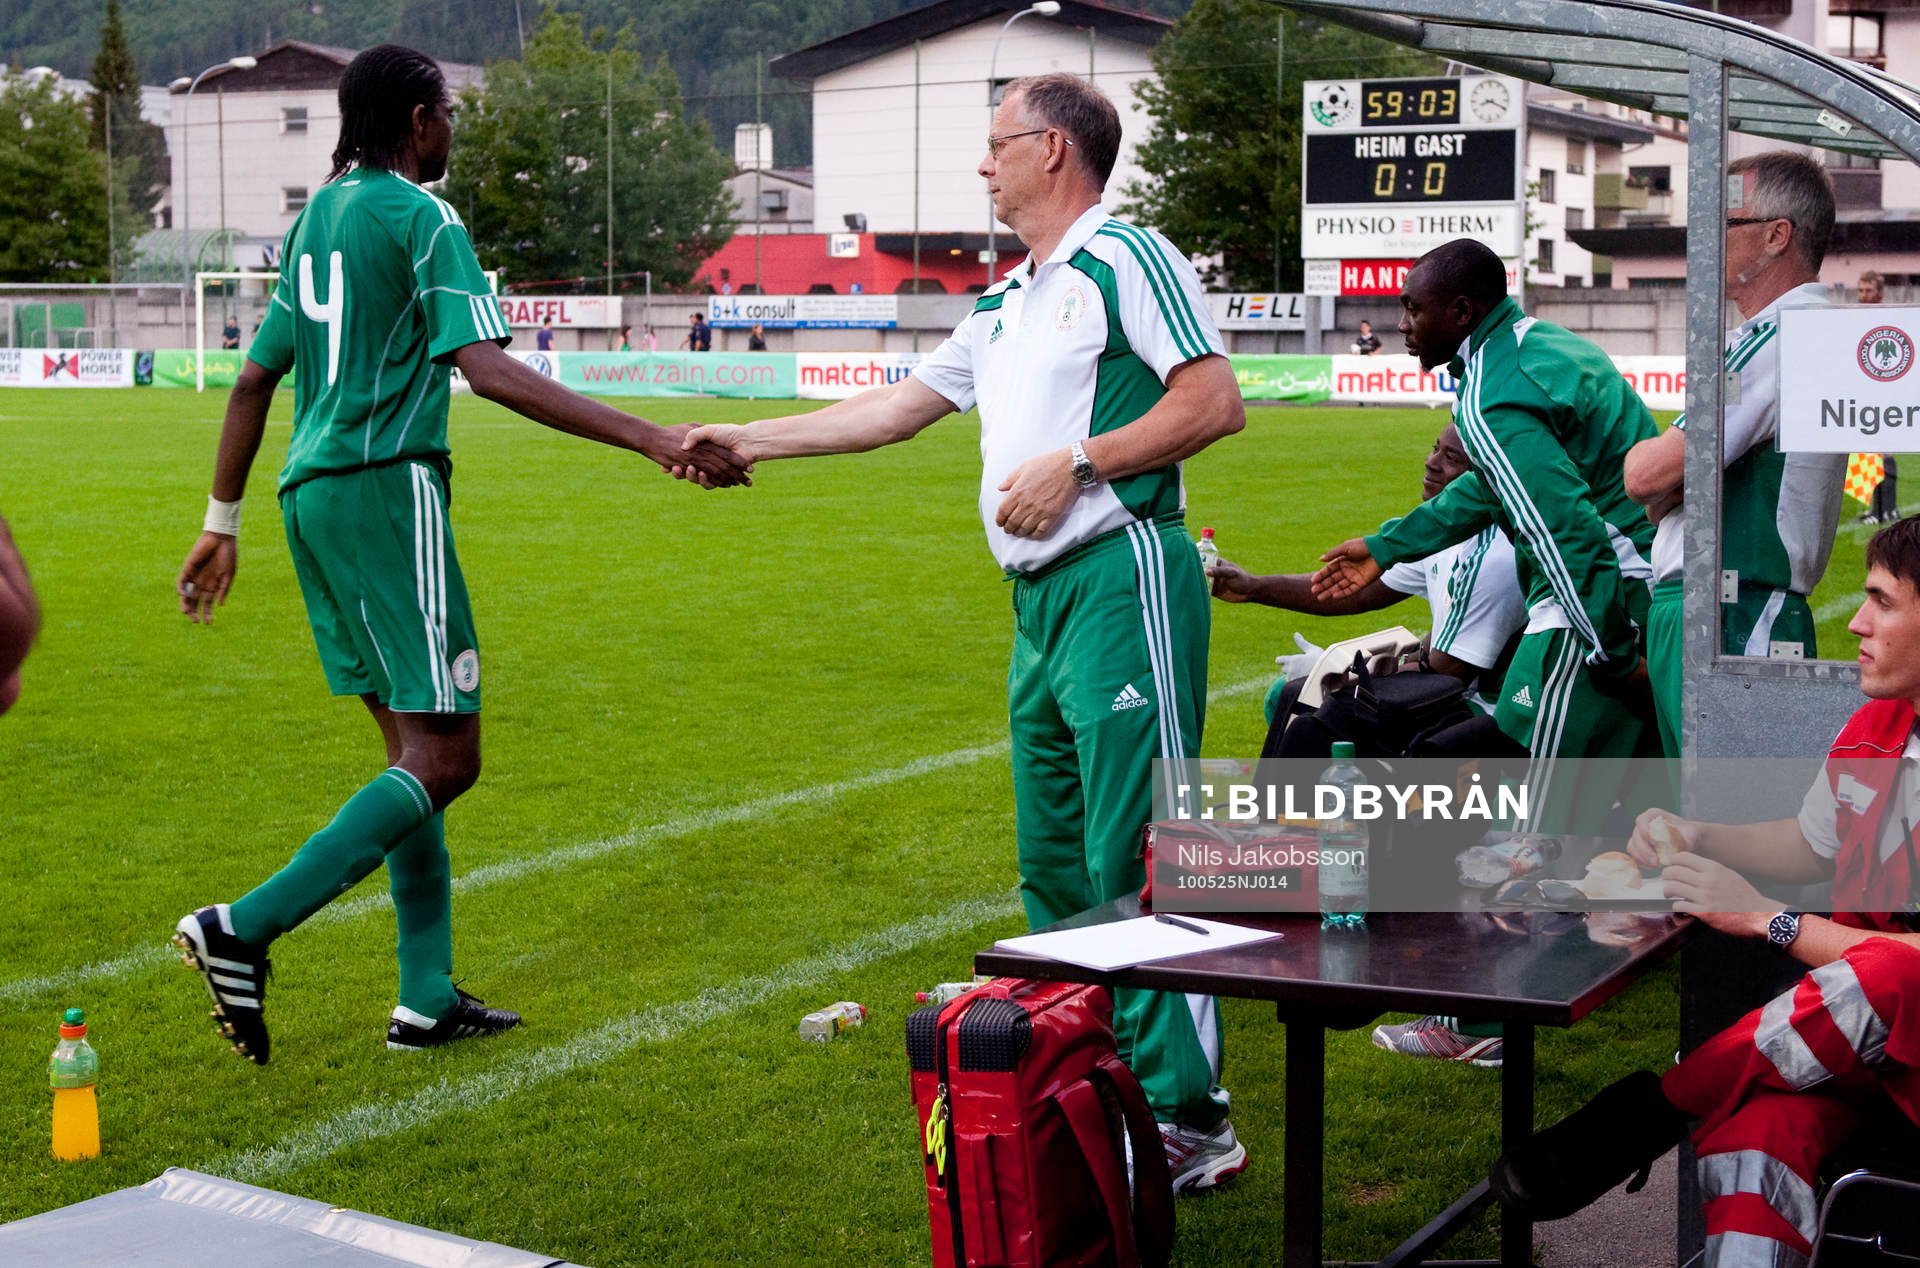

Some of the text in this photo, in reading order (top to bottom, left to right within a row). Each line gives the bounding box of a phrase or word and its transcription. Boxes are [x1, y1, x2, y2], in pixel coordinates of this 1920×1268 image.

[1367, 89, 1456, 118] 59:03
[1355, 134, 1466, 158] HEIM GAST
[1316, 215, 1493, 234] PHYSIO THERM
[1344, 266, 1409, 289] HAND
[500, 301, 572, 323] RAFFL
[746, 299, 796, 319] consult
[1227, 296, 1302, 318] HELL
[299, 250, 344, 386] 4
[1866, 329, 1905, 345] NIGERIA
[0, 351, 21, 361] WER
[81, 352, 122, 361] POWER
[81, 364, 121, 375] HORSE
[582, 357, 775, 385] www.zain.com
[1821, 399, 1920, 435] Niger
[1111, 696, 1149, 712] adidas
[1511, 695, 1534, 708] adidas
